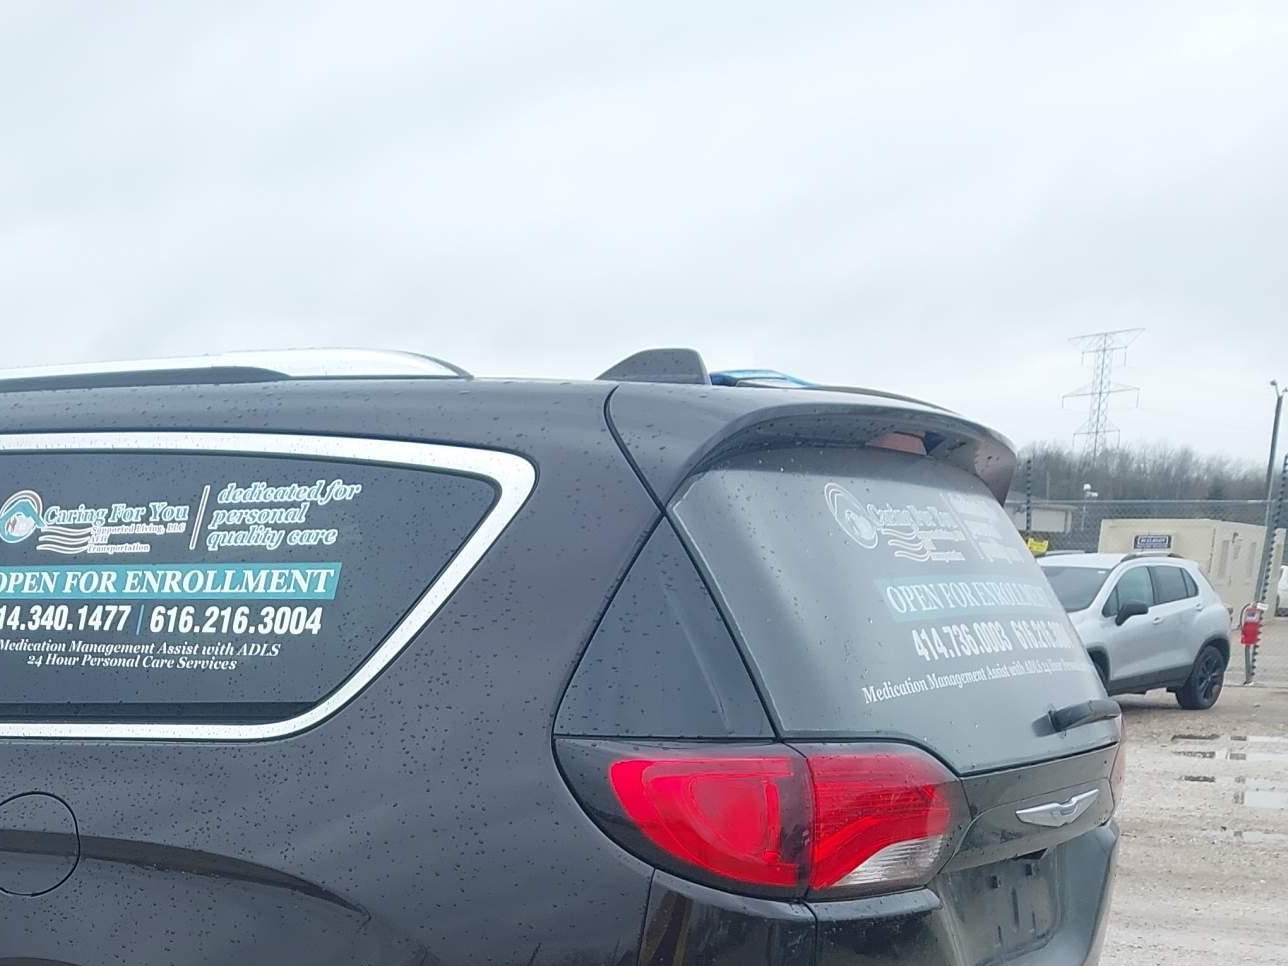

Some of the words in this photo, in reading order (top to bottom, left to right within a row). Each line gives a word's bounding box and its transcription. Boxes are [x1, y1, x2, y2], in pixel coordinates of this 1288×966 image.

[218, 480, 325, 504] dedicated
[318, 479, 362, 505] for
[44, 504, 108, 528] Caring
[109, 503, 147, 523] For
[150, 502, 190, 522] You
[208, 502, 310, 529] personal
[87, 542, 150, 554] Transportation
[207, 525, 286, 551] quality
[287, 528, 338, 546] care
[62, 571, 118, 593] FOR
[122, 569, 335, 593] ENROLLMENT
[886, 583, 945, 613] OPEN
[942, 582, 979, 609] FOR
[149, 606, 323, 634] 616.216.3004
[69, 640, 155, 656] Management
[156, 641, 200, 655] Assist
[201, 642, 234, 656] with
[236, 643, 281, 657] ADLS
[27, 654, 43, 667] 24
[46, 654, 79, 666] Hour
[81, 654, 140, 668] Personal
[142, 655, 174, 668] Care
[177, 656, 238, 670] Services
[862, 676, 929, 704] Medication
[926, 668, 988, 690] Management
